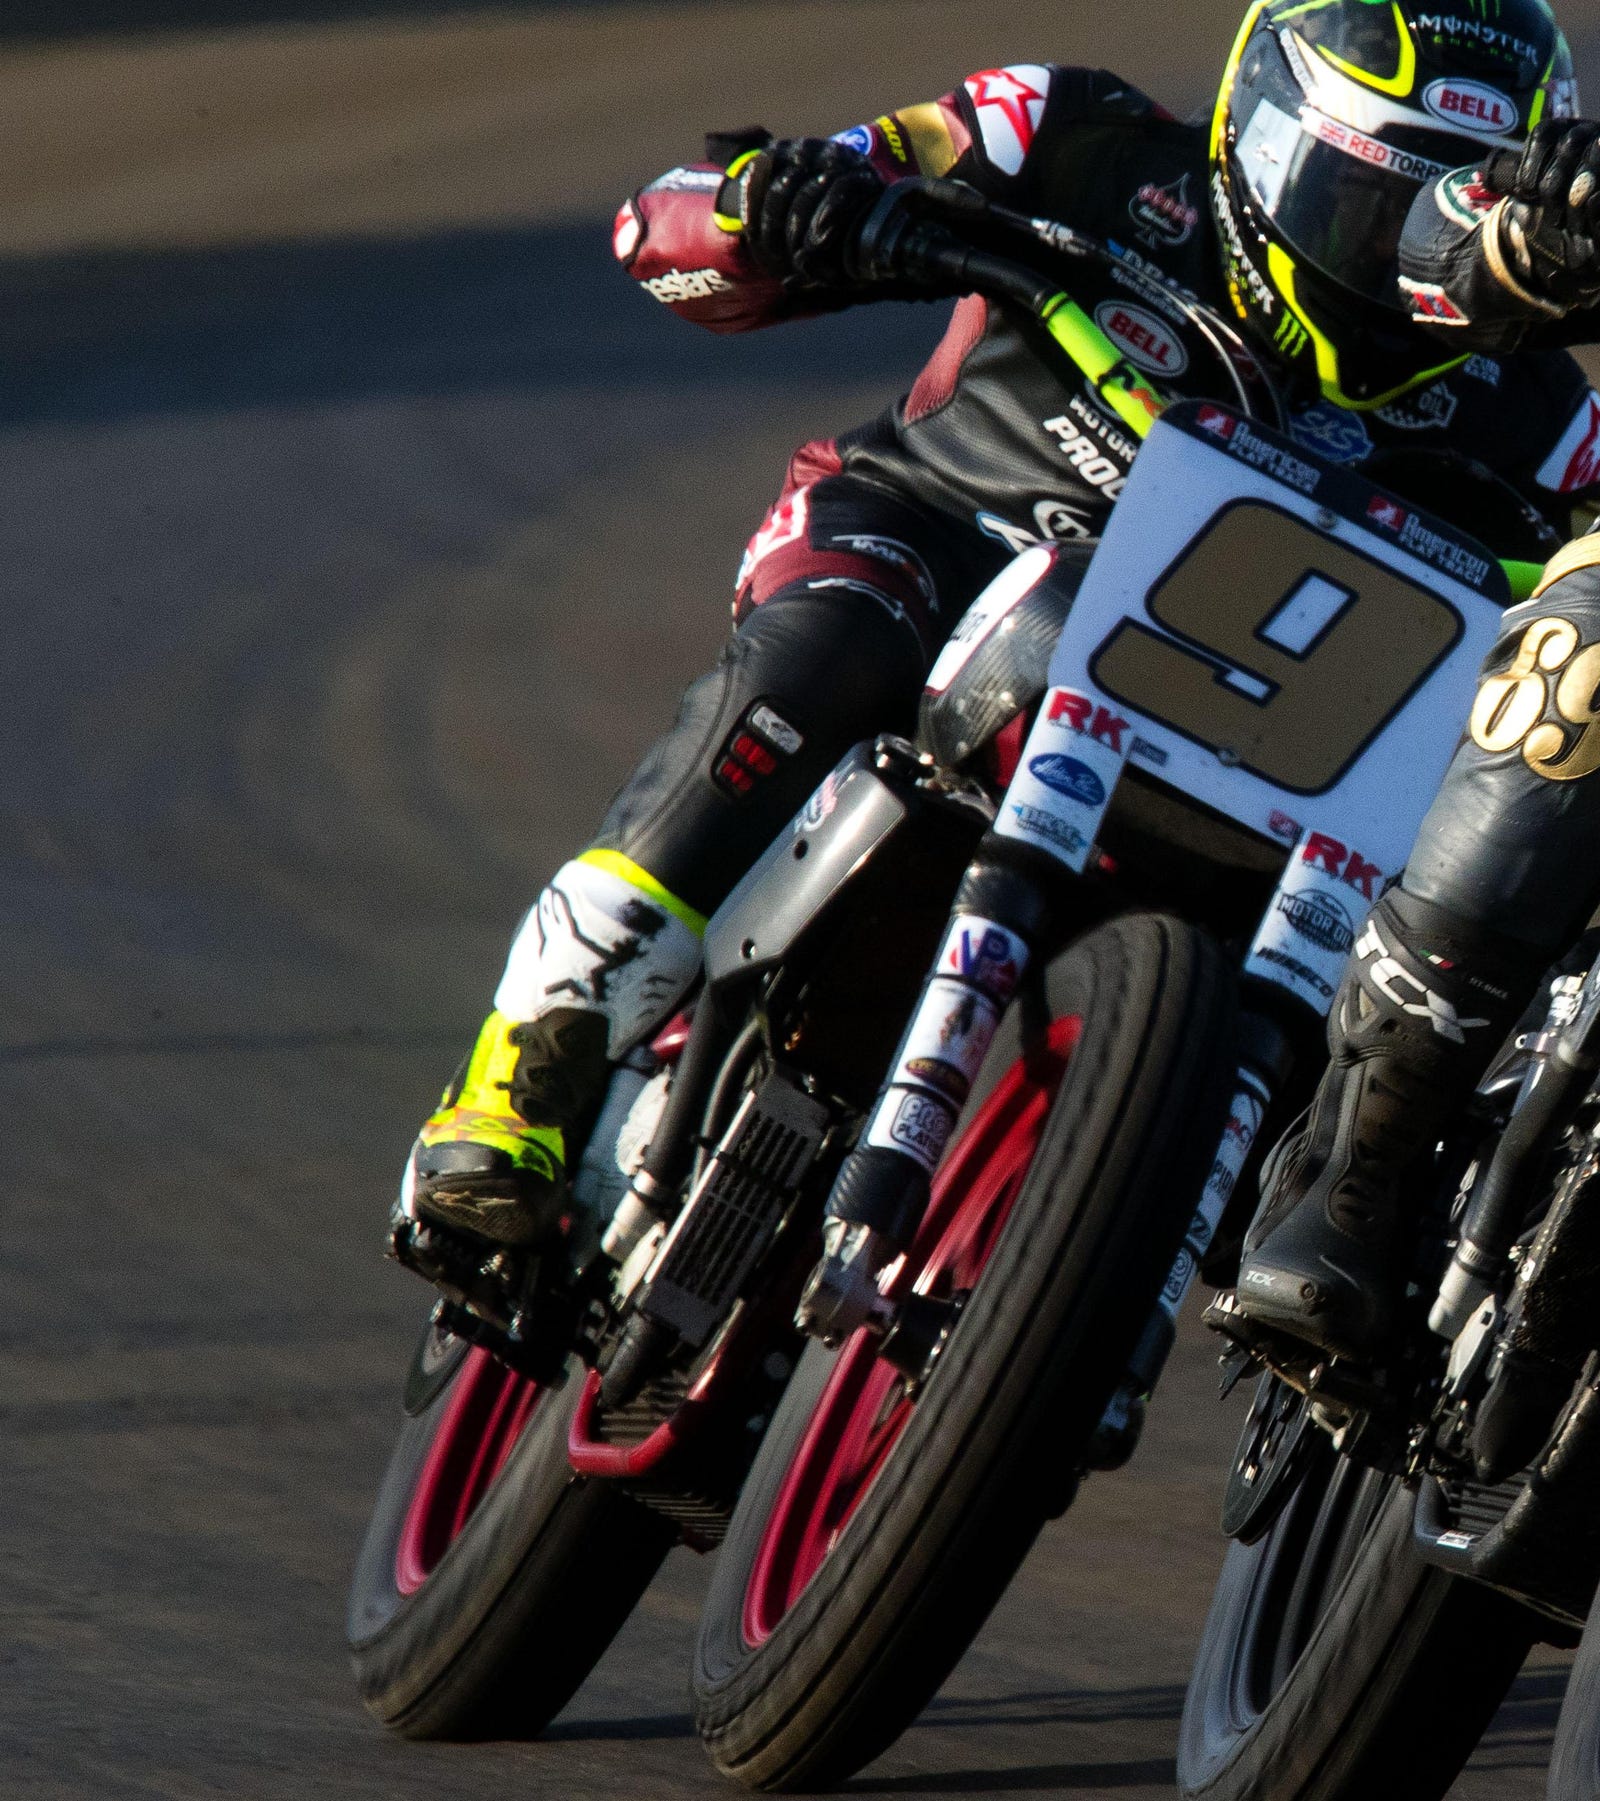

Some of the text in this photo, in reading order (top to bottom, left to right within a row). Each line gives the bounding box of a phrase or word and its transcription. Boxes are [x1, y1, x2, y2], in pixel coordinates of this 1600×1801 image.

[1439, 88, 1504, 126] BELL
[1109, 310, 1170, 366] BELL
[1089, 497, 1466, 797] 9
[1048, 691, 1130, 754] RK
[1302, 831, 1382, 901] RK
[1356, 919, 1492, 1045] TCX
[1246, 1269, 1276, 1287] TCX
